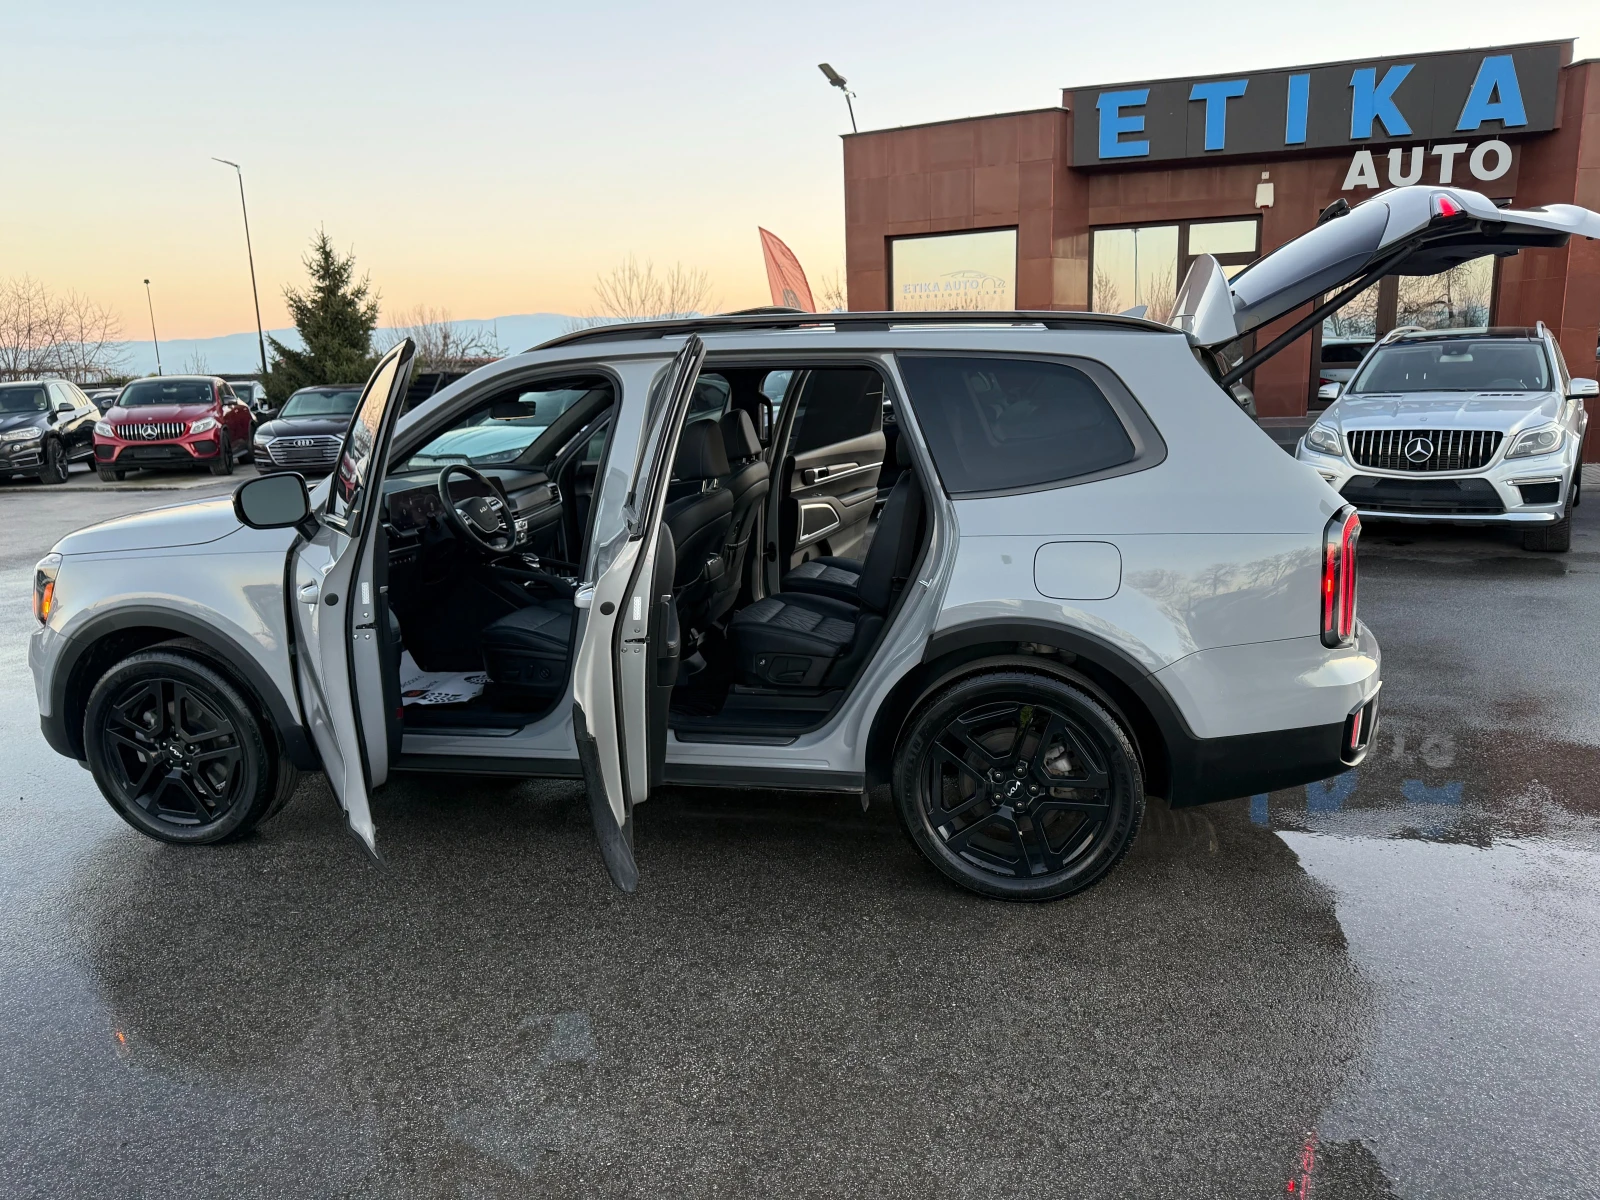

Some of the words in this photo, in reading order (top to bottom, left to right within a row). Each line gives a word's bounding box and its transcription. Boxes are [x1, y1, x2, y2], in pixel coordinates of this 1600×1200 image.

[1096, 54, 1528, 159] ETIKA
[1342, 140, 1513, 190] AUTO
[903, 282, 940, 294] ETIKA
[944, 279, 979, 292] AUTO
